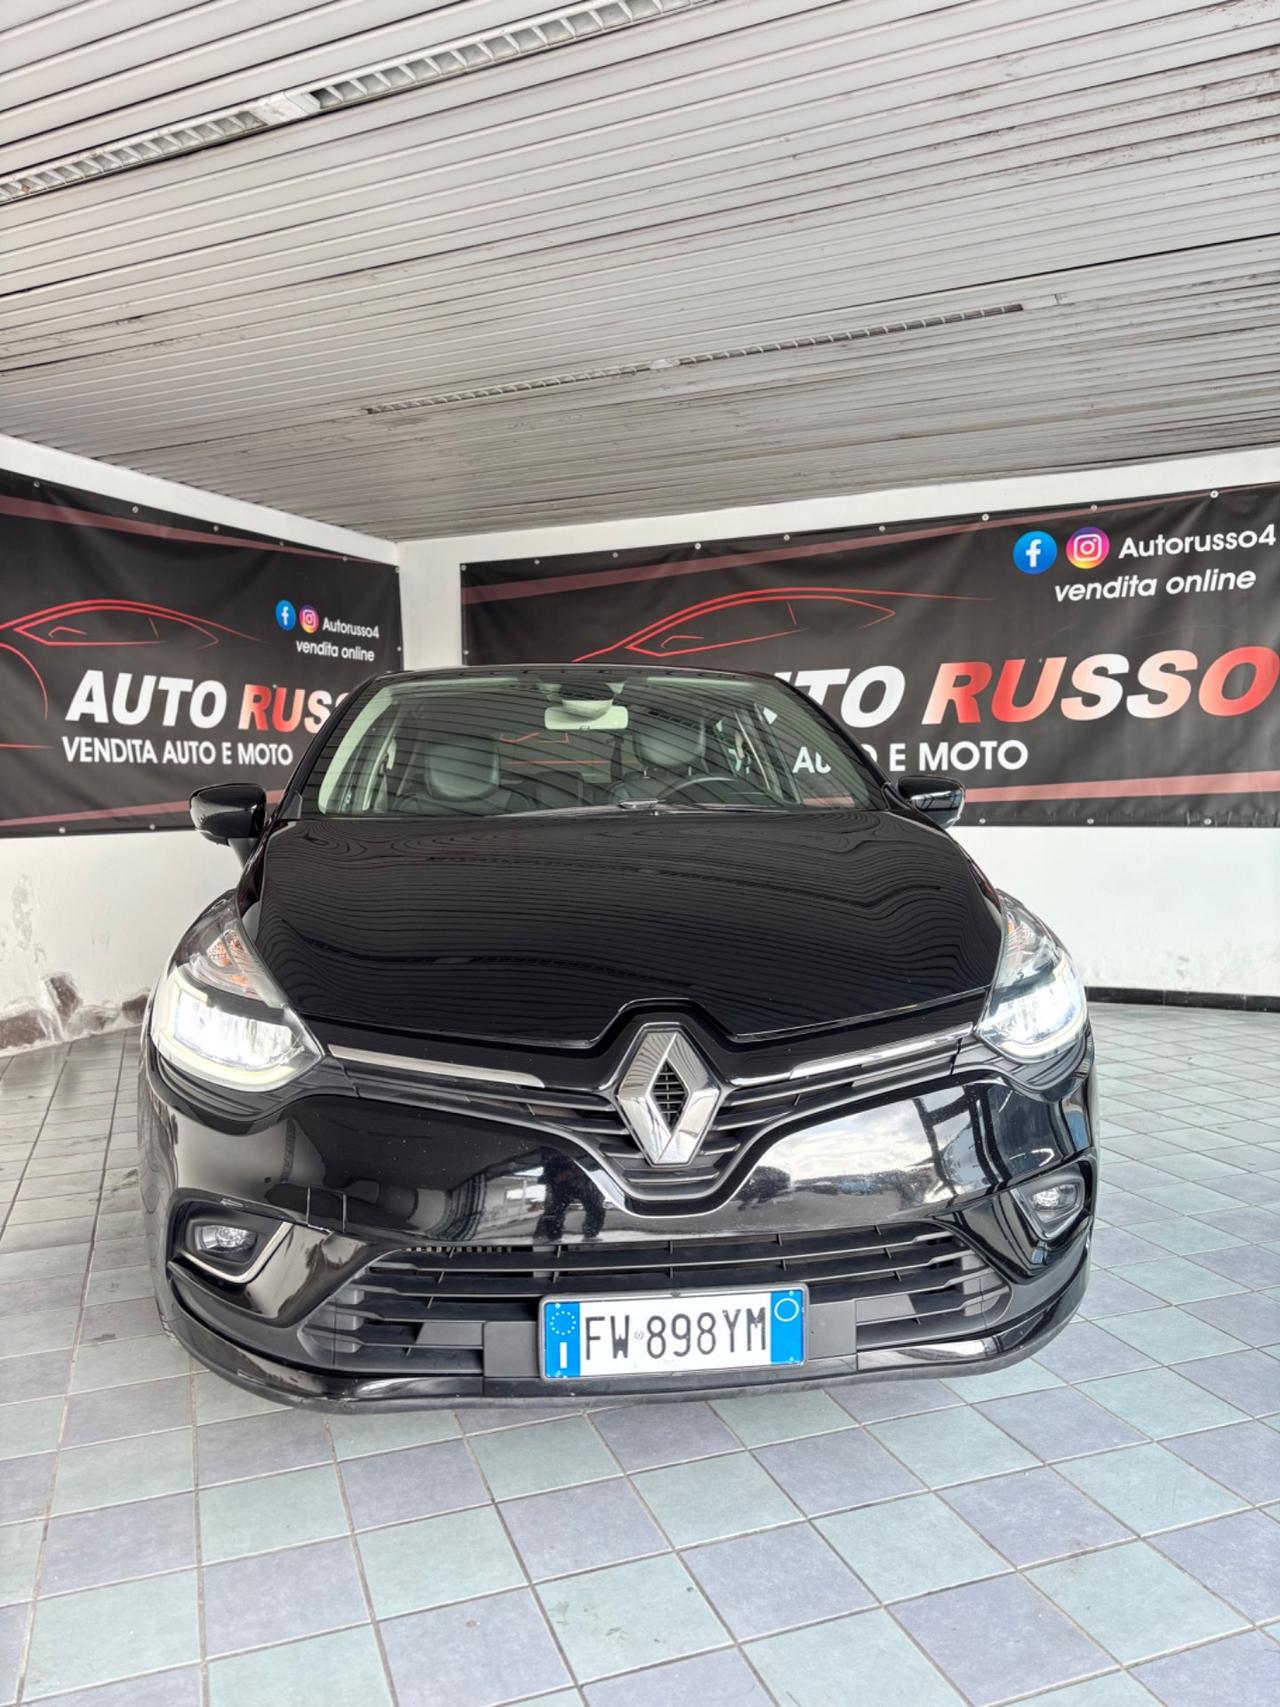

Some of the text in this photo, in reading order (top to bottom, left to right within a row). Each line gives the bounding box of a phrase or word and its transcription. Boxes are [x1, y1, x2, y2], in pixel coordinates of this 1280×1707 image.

[1118, 523, 1277, 560] Autorusso4
[1054, 568, 1257, 602] vendita online
[322, 616, 380, 640] Autorusso4
[295, 639, 375, 662] vendita online
[65, 669, 350, 734] AUTO RUS
[921, 646, 1280, 725] RUSSO
[62, 735, 293, 766] VENDITA AUTO E MOTO
[889, 742, 906, 772] E
[919, 740, 1029, 772] MOTO
